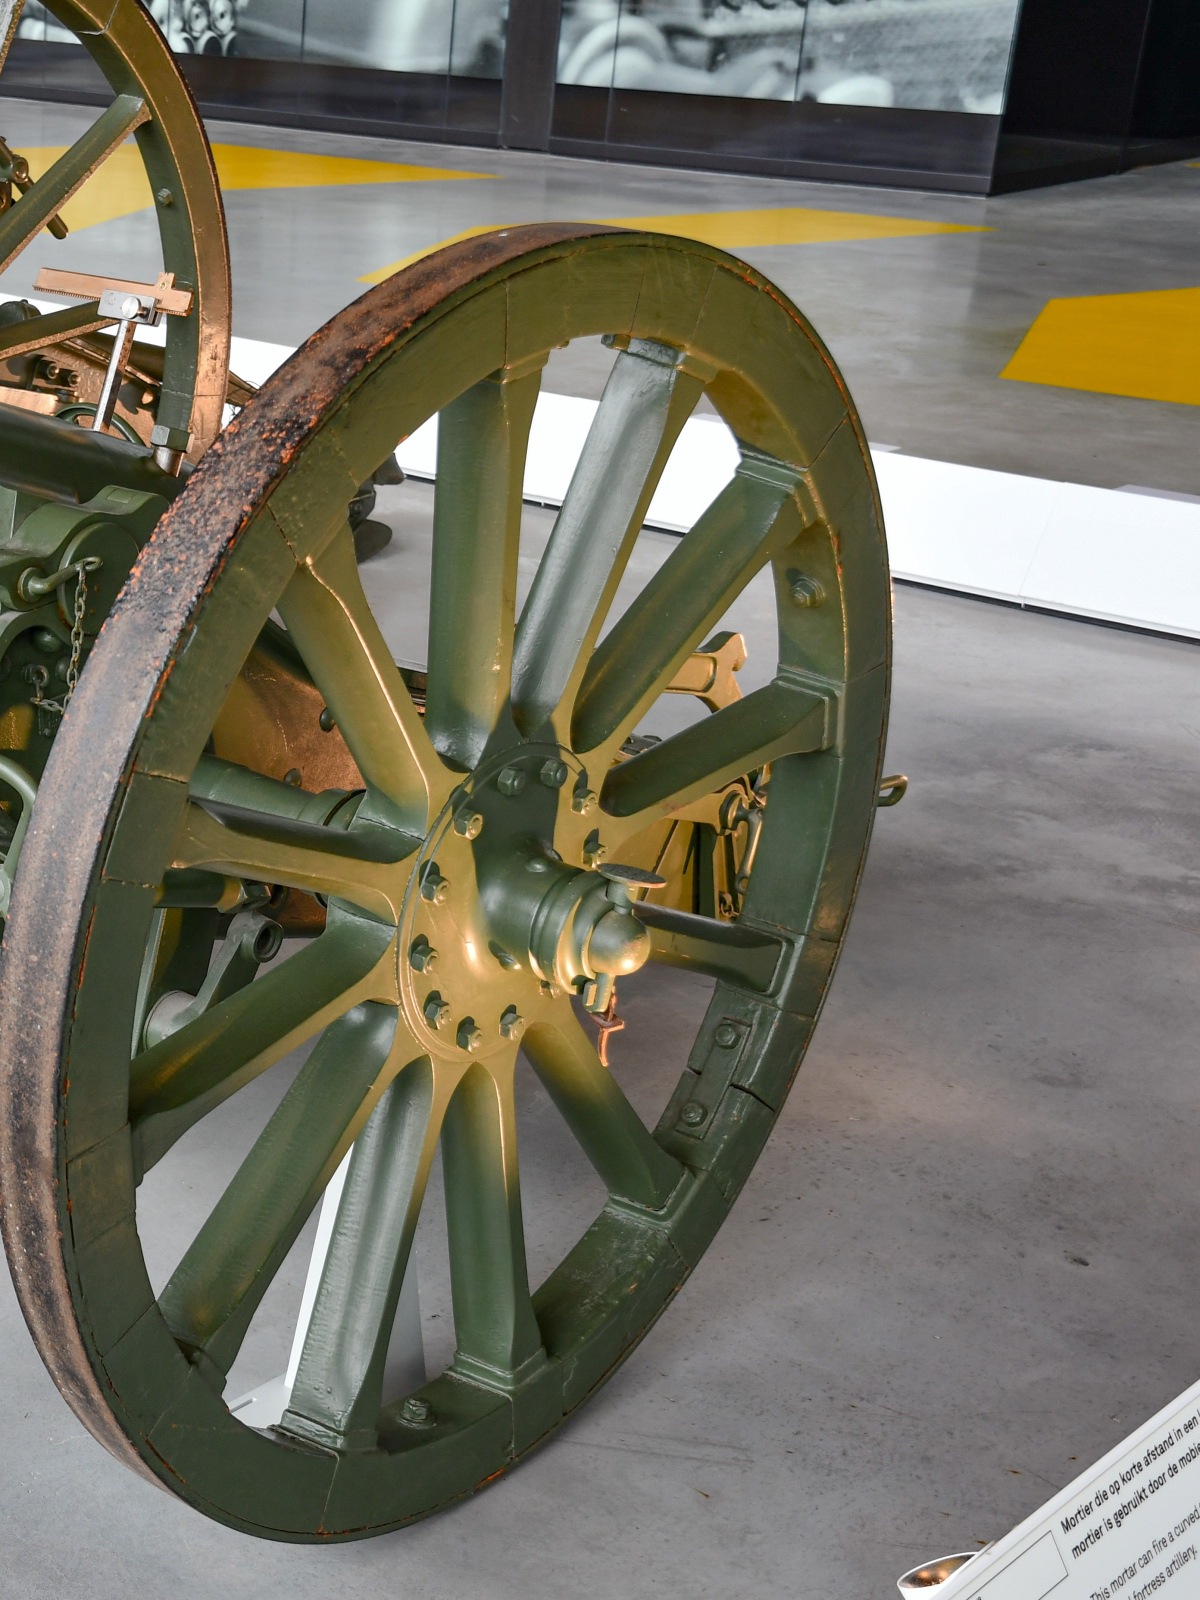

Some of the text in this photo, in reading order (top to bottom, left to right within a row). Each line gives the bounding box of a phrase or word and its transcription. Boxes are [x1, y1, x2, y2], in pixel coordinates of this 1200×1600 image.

[1060, 1416, 1199, 1534] Mortier die op korte afstand in een
[1071, 1525, 1104, 1559] mortier
[1102, 1518, 1113, 1532] is
[1113, 1487, 1149, 1528] gebruikt
[1148, 1472, 1167, 1494] door
[1167, 1463, 1179, 1478] de
[1110, 1562, 1137, 1593] mortar
[1138, 1550, 1154, 1568] can
[1152, 1537, 1168, 1555] fire
[1168, 1532, 1175, 1543] a
[1174, 1505, 1200, 1537] curved
[1133, 1545, 1197, 1600] fortress artillery.
